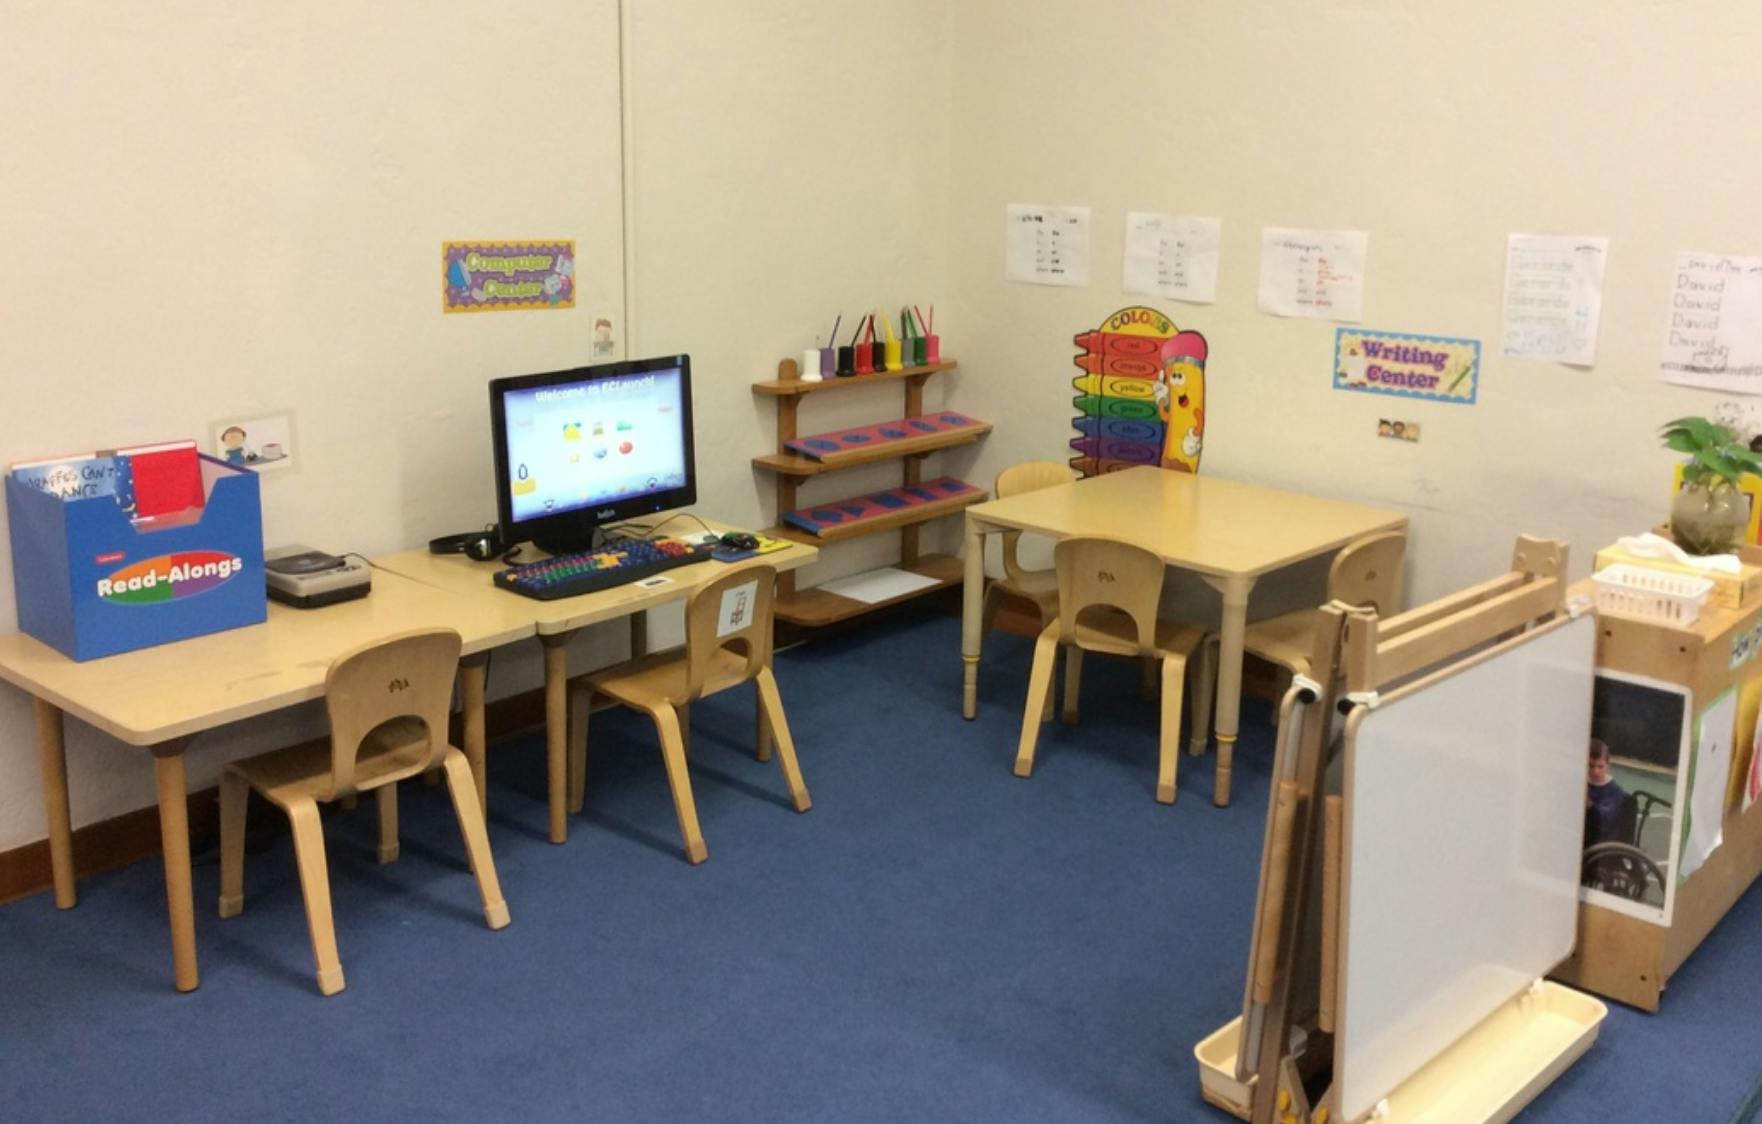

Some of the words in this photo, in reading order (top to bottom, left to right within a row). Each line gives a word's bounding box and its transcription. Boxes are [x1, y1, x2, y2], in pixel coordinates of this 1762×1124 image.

[465, 252, 553, 277] Computer
[482, 279, 545, 298] Center
[1677, 273, 1725, 293] David
[1673, 293, 1722, 312] David
[1110, 310, 1170, 335] COLORS
[1671, 312, 1720, 331] David
[1361, 340, 1449, 372] Writing
[1366, 364, 1439, 389] Center
[535, 387, 585, 401] Welcome
[1120, 383, 1145, 394] yellow
[97, 557, 243, 597] Read-Alongs
